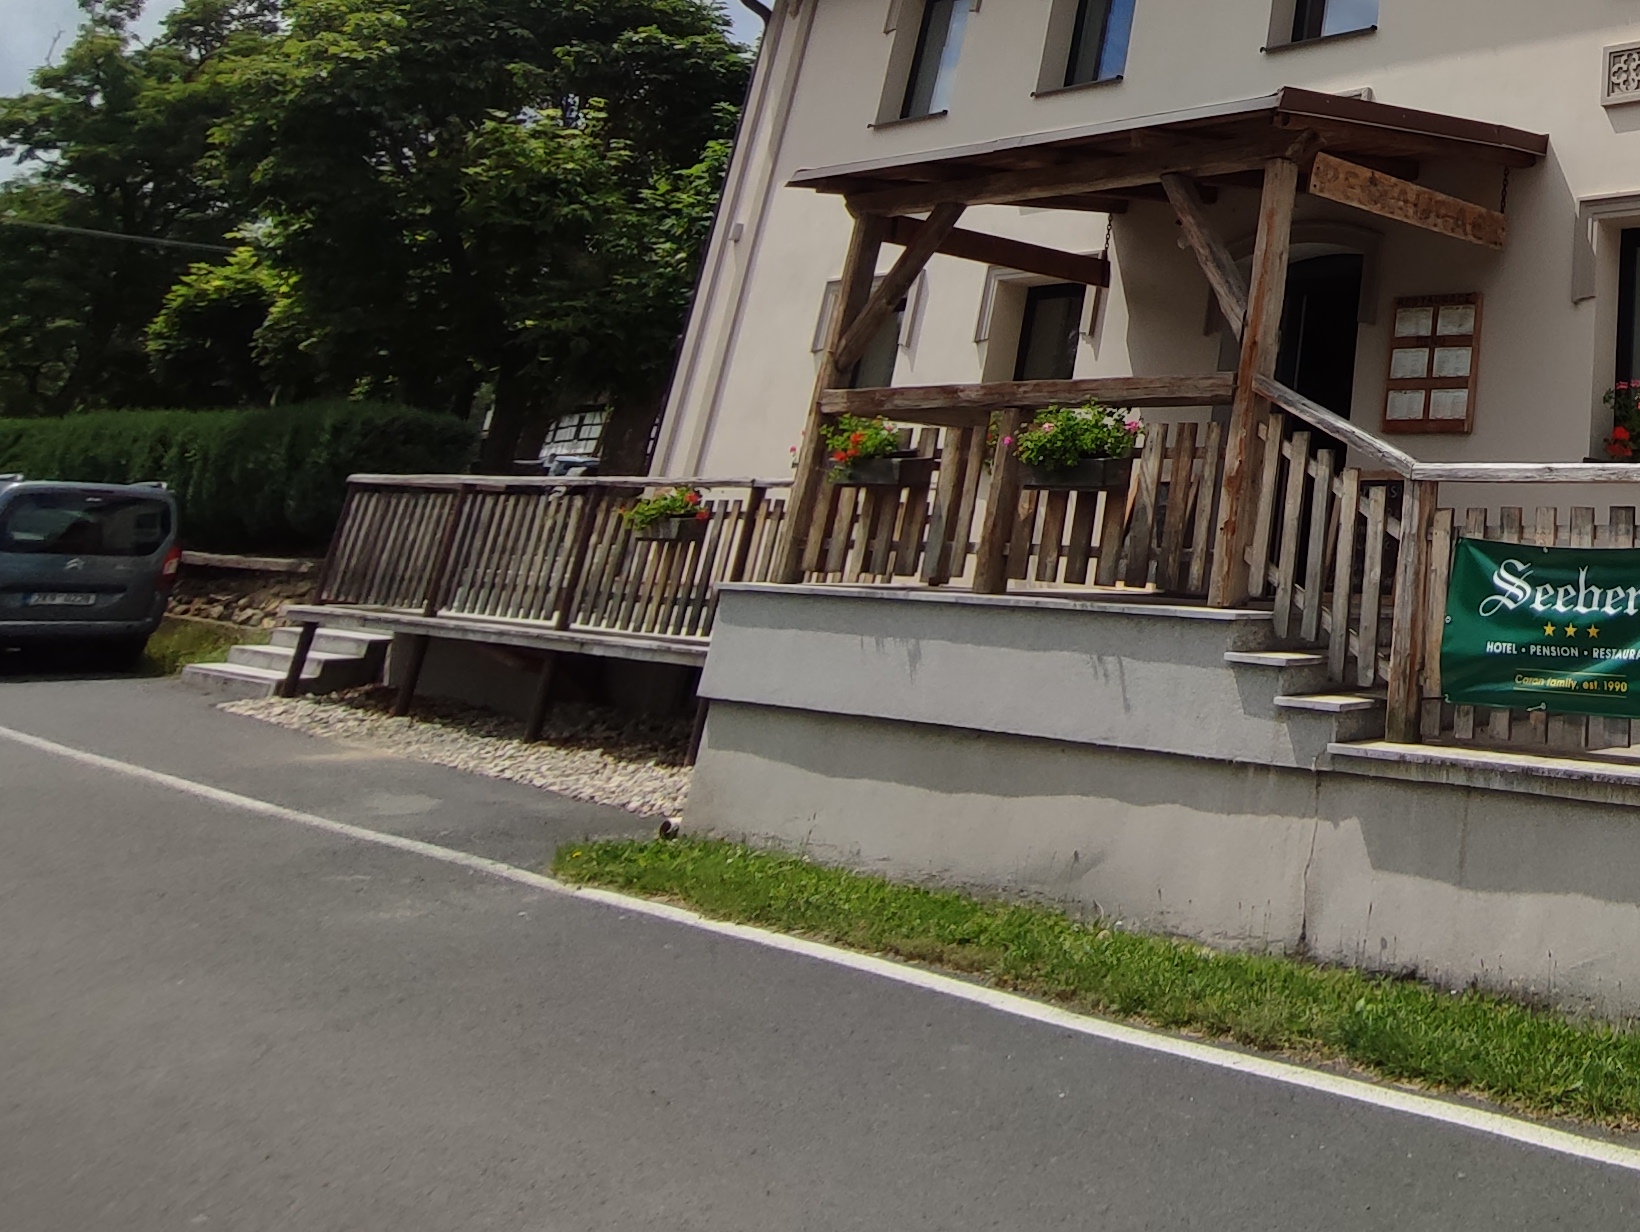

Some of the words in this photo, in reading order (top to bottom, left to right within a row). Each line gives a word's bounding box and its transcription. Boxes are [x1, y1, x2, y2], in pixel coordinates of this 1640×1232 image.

[1486, 641, 1517, 655] HOTEL
[1530, 645, 1579, 657] PENSION
[1603, 681, 1627, 692] 1990
